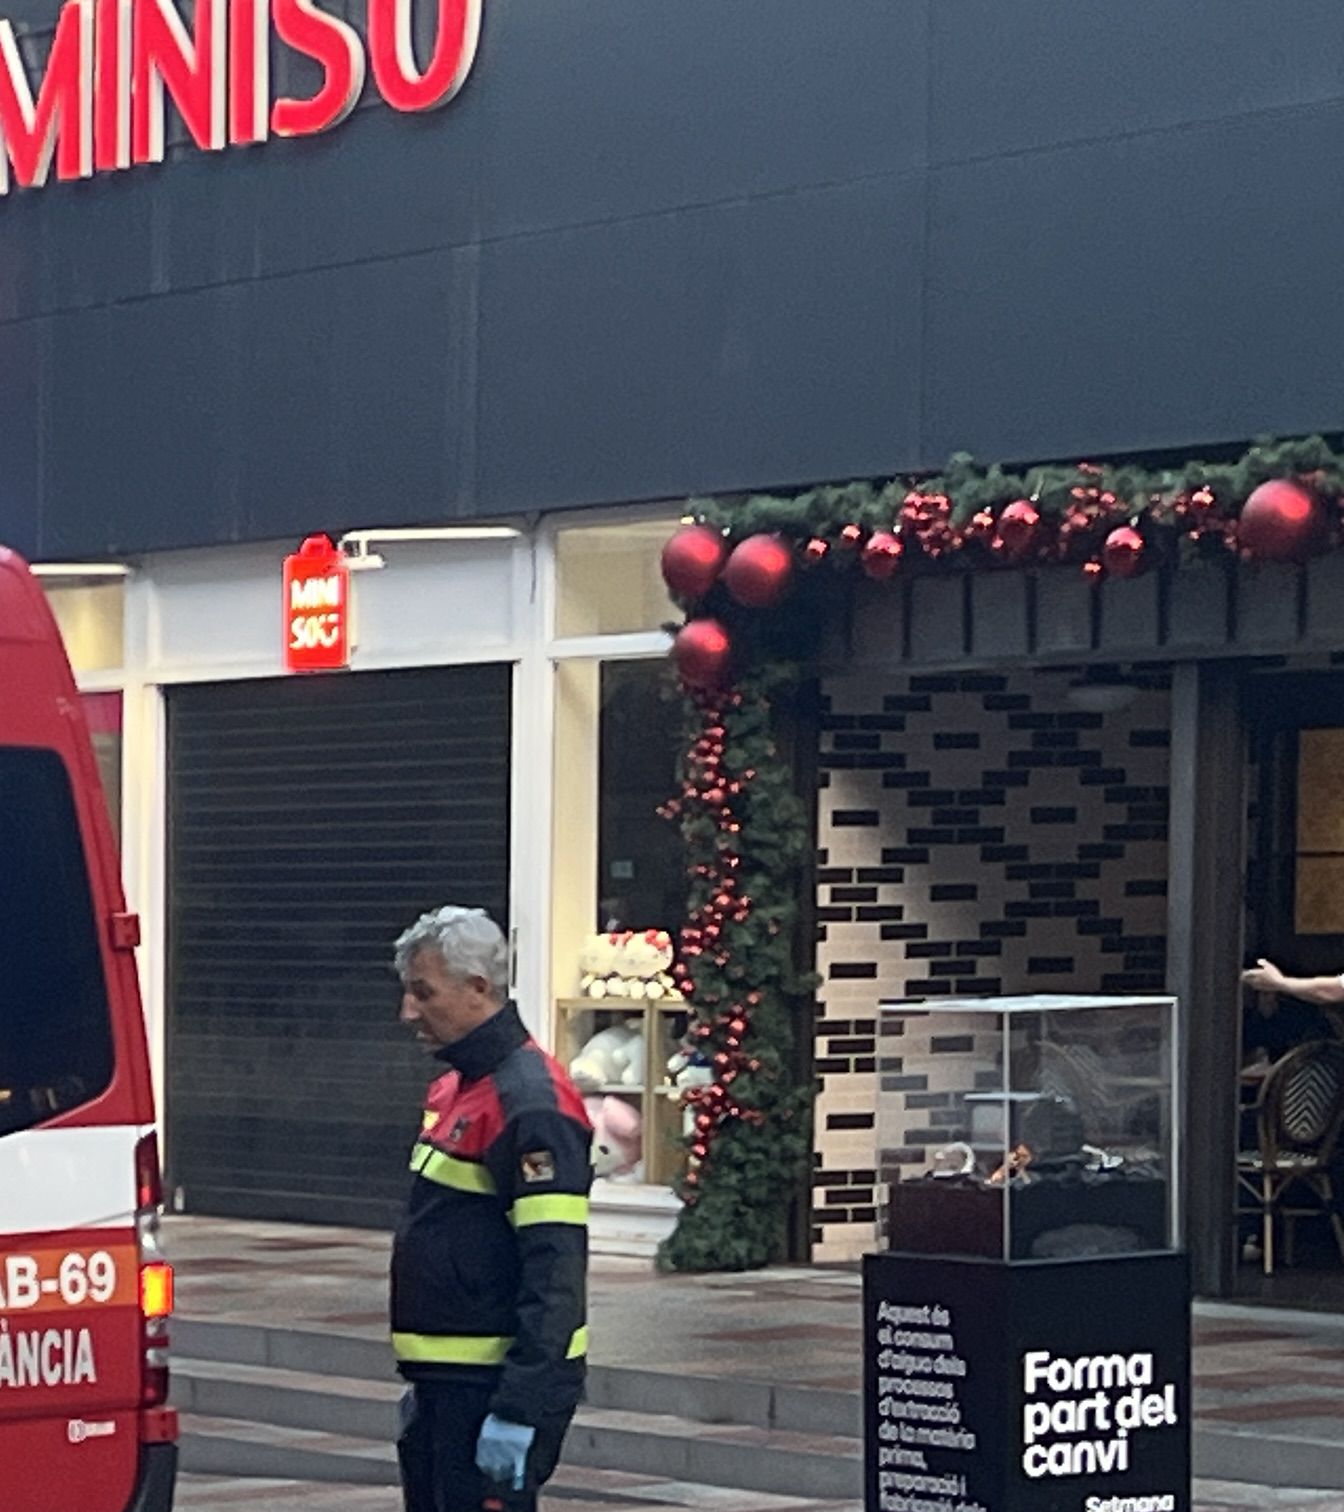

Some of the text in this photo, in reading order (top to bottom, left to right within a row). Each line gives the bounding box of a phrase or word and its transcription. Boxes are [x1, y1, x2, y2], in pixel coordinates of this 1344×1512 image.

[290, 572, 339, 610] MINI
[1024, 1350, 1154, 1395] Forma
[1023, 1383, 1178, 1445] part del
[1022, 1427, 1129, 1478] canvi
